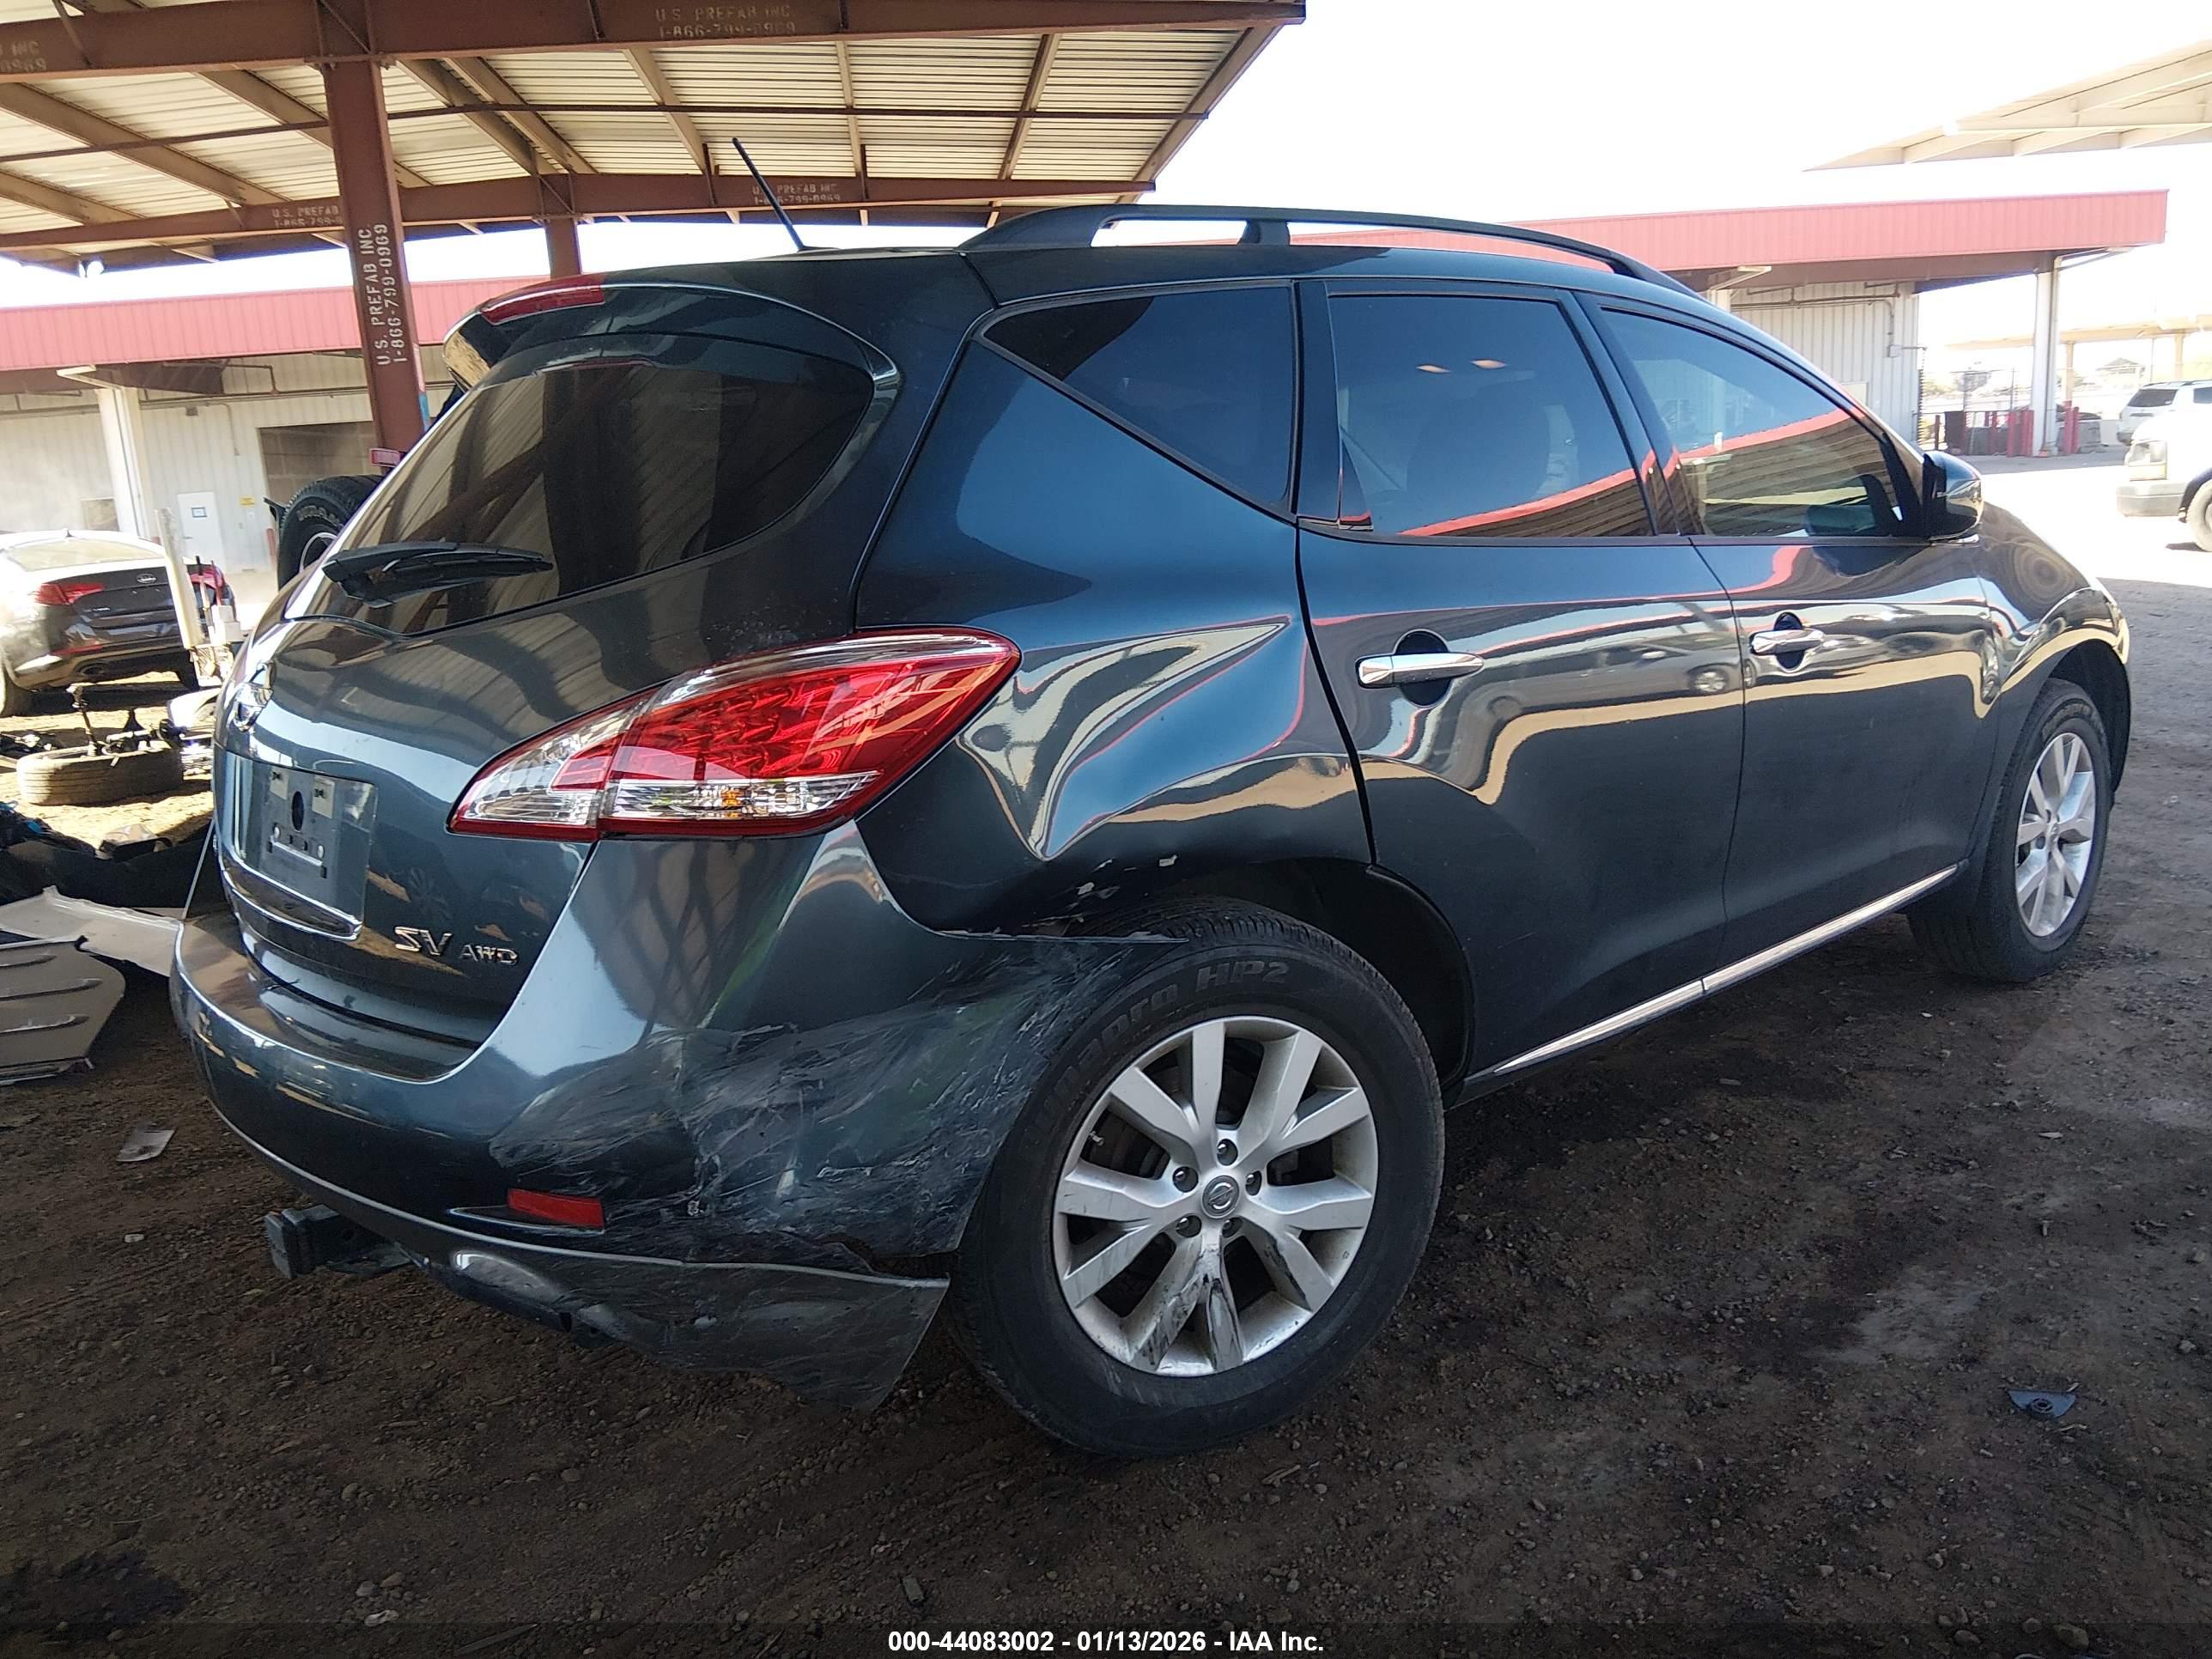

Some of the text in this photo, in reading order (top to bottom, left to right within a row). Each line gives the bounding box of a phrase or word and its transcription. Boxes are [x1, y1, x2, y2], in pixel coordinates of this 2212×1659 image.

[695, 6, 757, 21] PREFAB
[297, 205, 339, 217] PREFAB
[362, 263, 386, 325] PREFAB
[374, 224, 408, 362] 1-866-799-0969
[375, 334, 392, 365] U.S.
[395, 927, 519, 966] SV AWD
[1194, 960, 1289, 994] HP2
